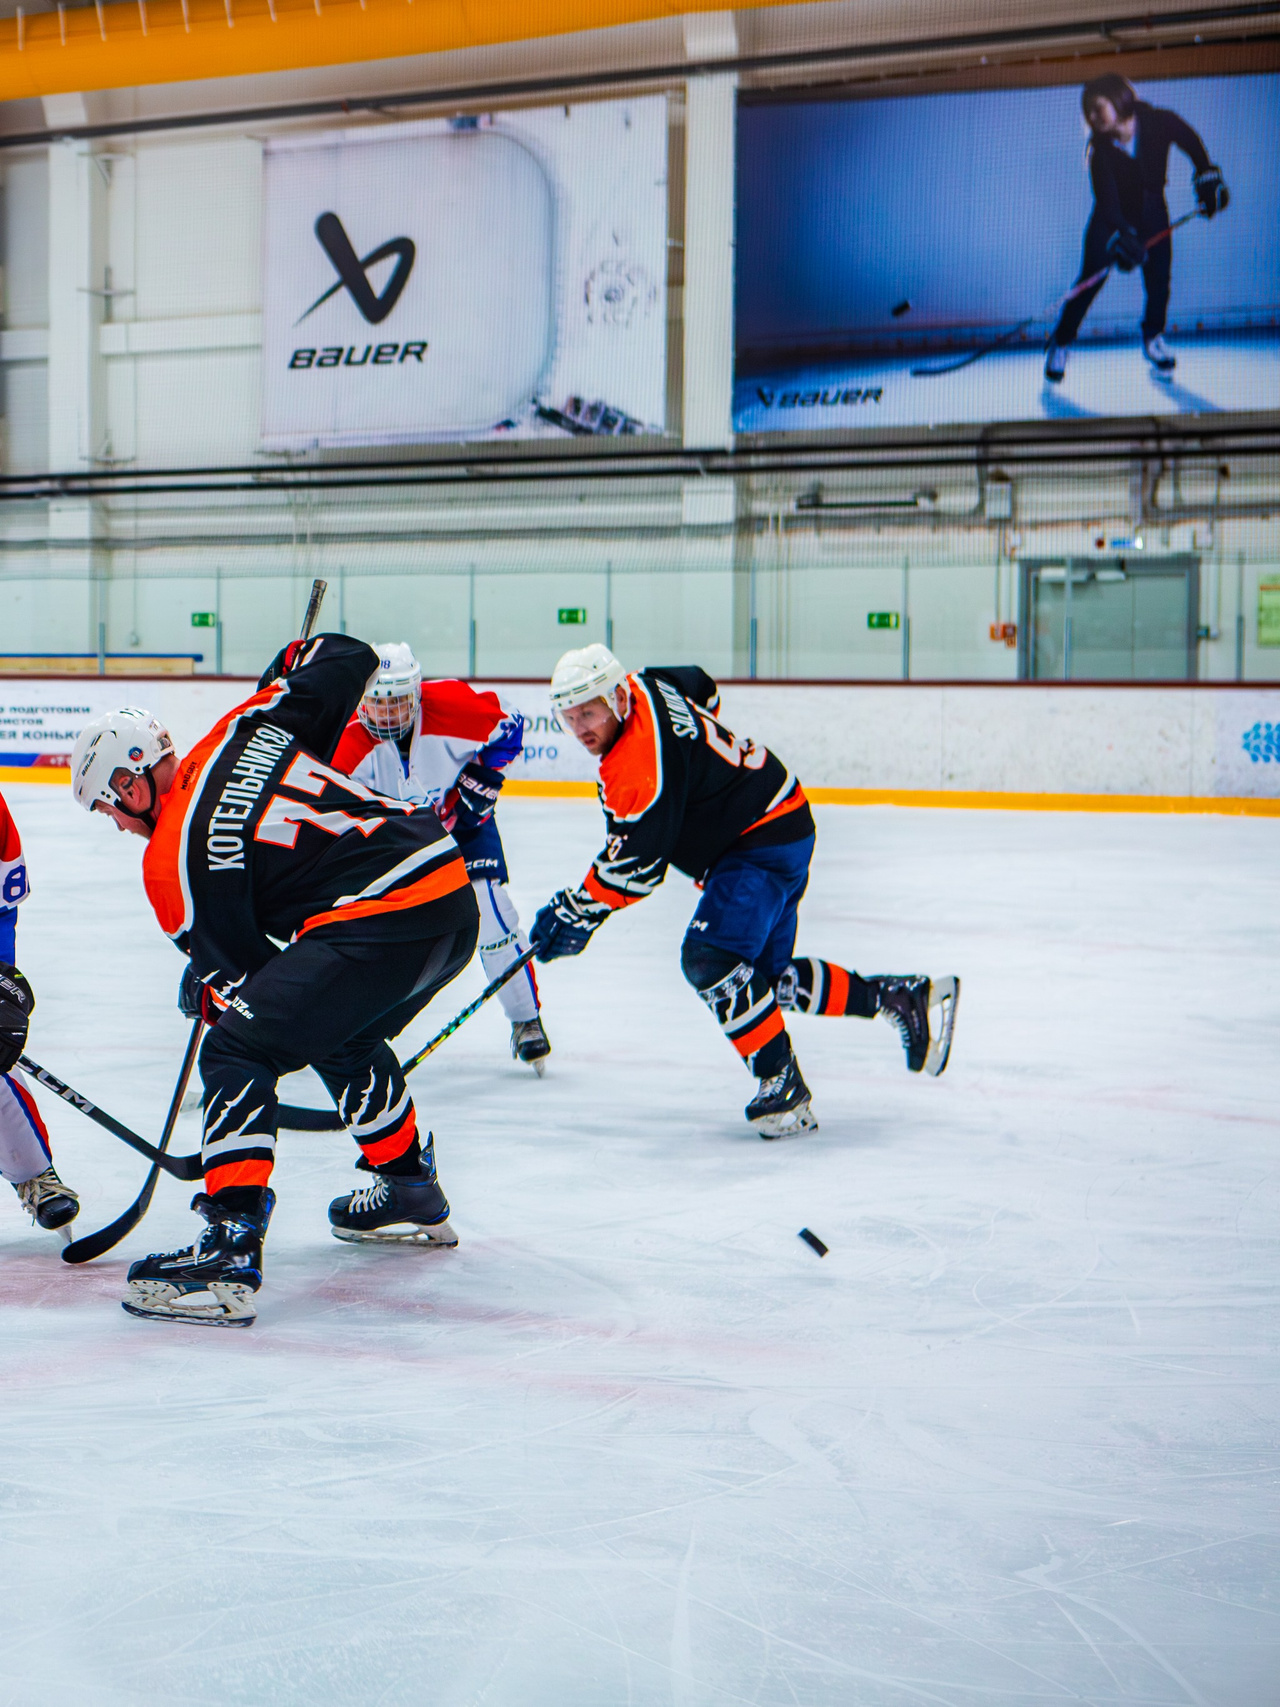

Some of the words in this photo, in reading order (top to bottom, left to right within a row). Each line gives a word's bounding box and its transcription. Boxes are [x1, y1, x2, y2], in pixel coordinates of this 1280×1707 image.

[288, 341, 428, 369] BAUER
[779, 387, 883, 408] BAUER
[9, 705, 91, 715] подготовки
[253, 750, 417, 850] 77
[2, 865, 30, 903] 8
